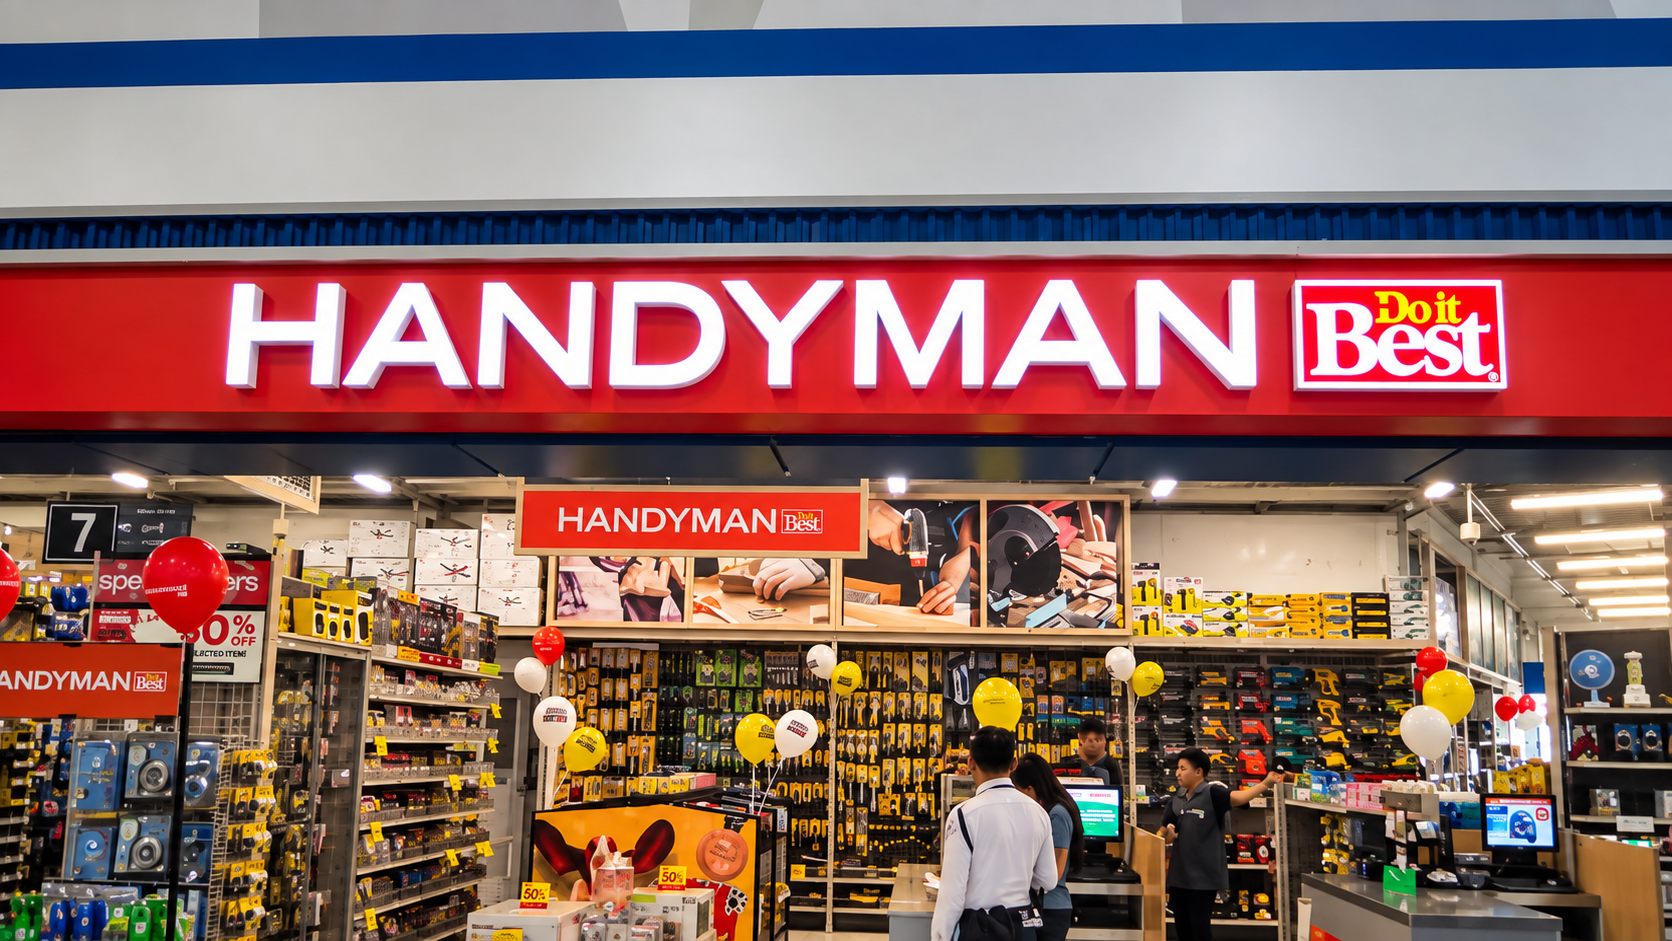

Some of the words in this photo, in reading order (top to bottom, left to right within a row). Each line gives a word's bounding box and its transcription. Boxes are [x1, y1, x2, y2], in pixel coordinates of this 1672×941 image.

[1374, 291, 1432, 324] Do
[1433, 290, 1462, 324] it
[225, 279, 1258, 391] HANDYMAN
[1305, 302, 1495, 377] Best
[70, 512, 97, 553] 7
[557, 506, 777, 534] HANDYMAN
[783, 514, 821, 532] Best
[230, 635, 257, 647] OFF
[136, 675, 165, 690] Best
